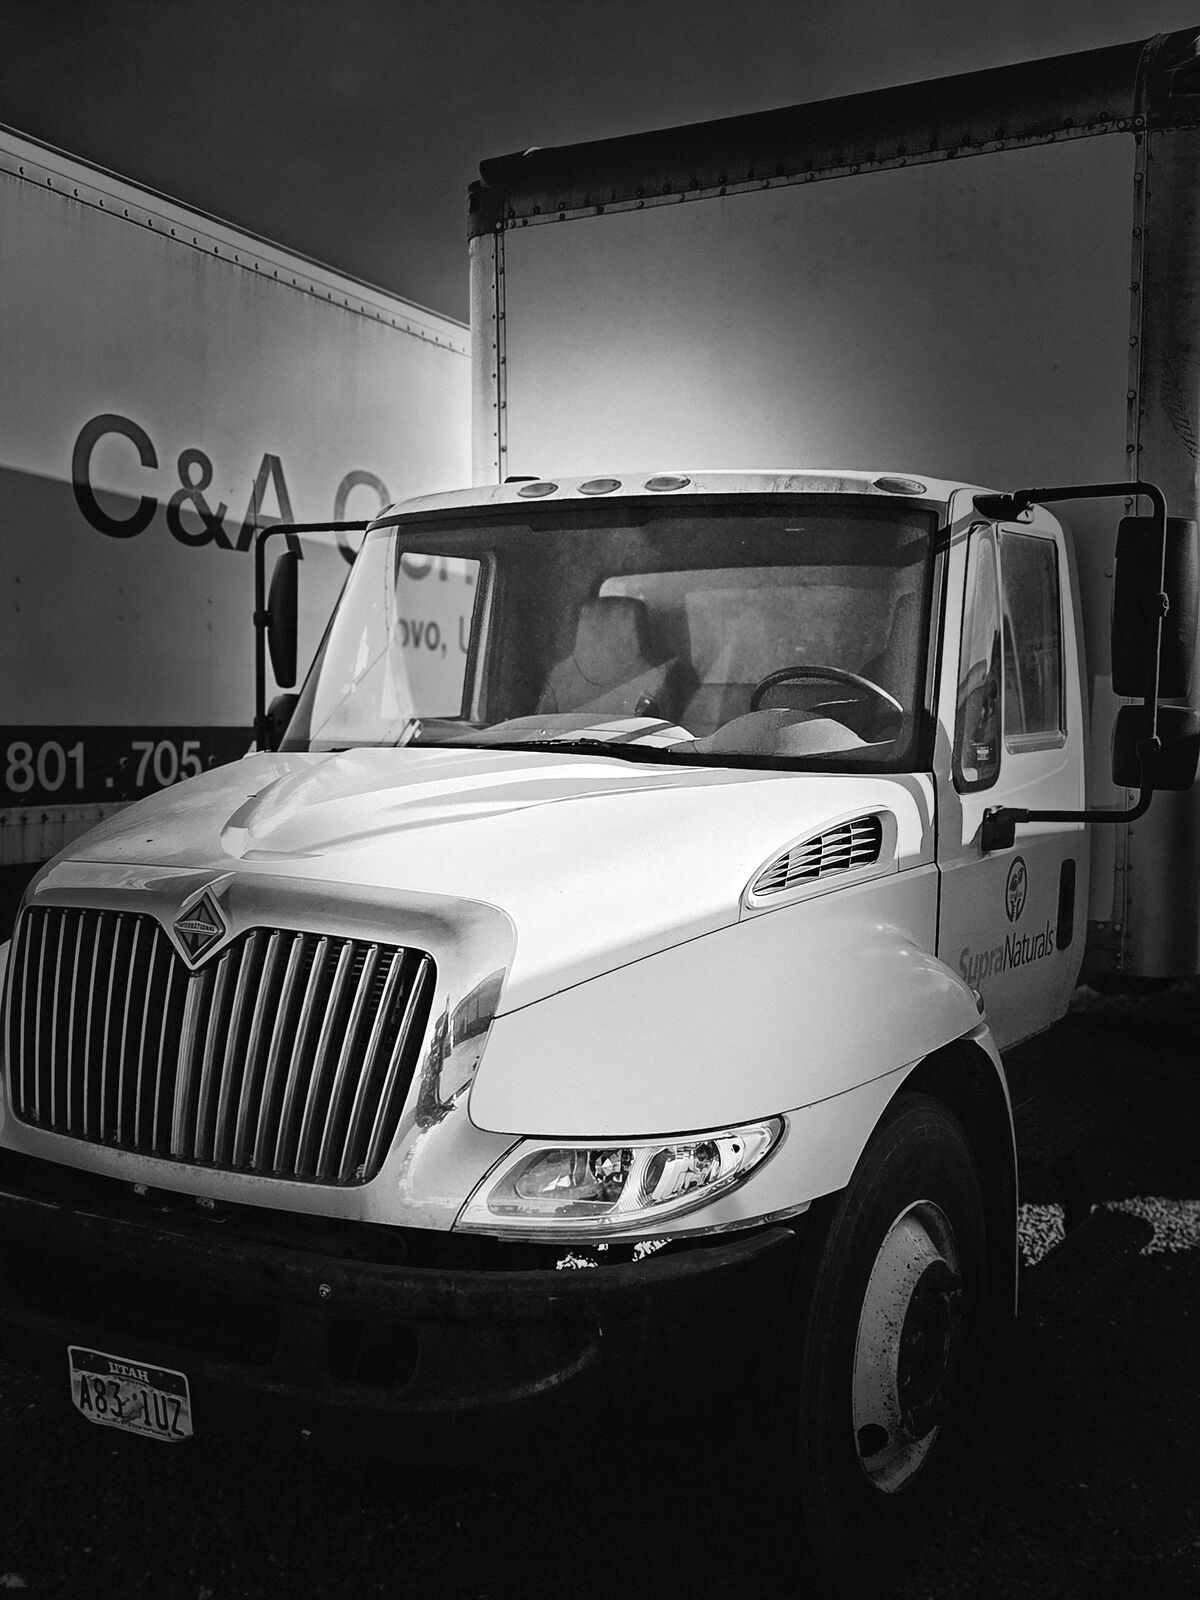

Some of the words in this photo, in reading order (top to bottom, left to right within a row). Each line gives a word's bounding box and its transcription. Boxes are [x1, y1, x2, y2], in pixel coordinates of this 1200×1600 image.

[71, 413, 304, 562] C&A
[5, 740, 85, 792] 801
[131, 740, 202, 787] 705
[959, 919, 1054, 990] SupraNaturals
[108, 1361, 150, 1383] UTAH
[80, 1374, 123, 1418] A83
[140, 1389, 185, 1436] 1UZ
